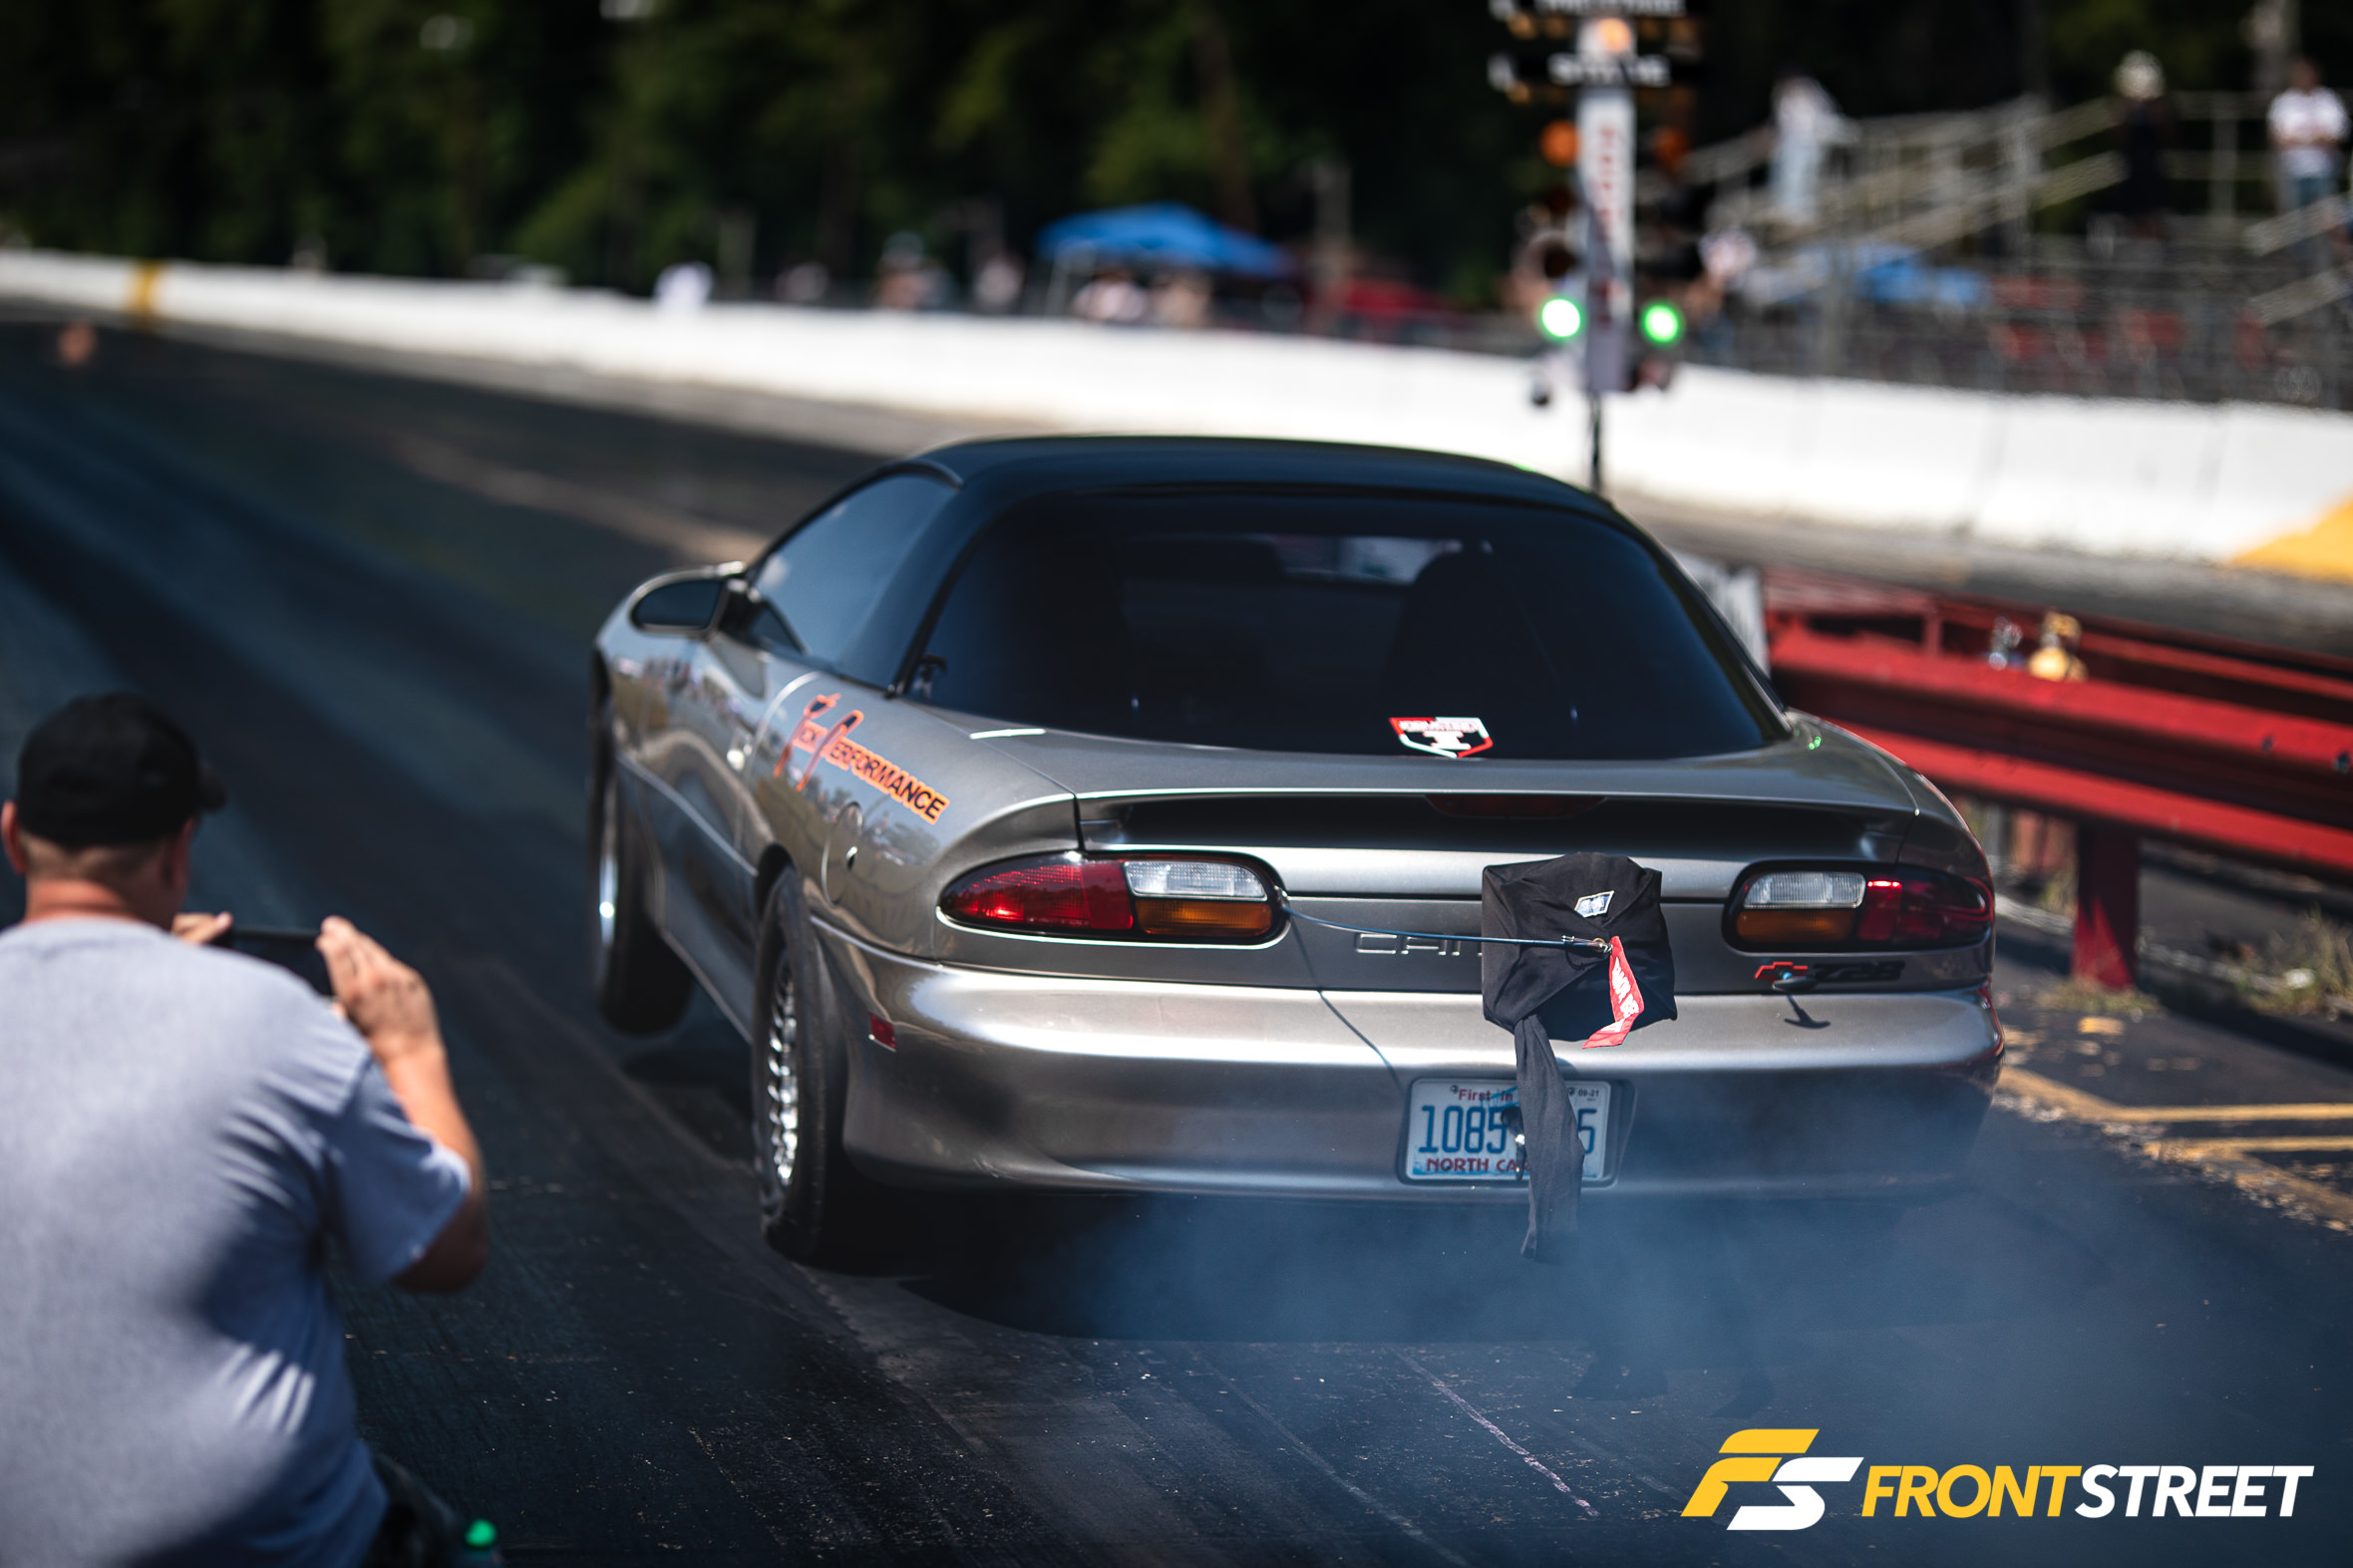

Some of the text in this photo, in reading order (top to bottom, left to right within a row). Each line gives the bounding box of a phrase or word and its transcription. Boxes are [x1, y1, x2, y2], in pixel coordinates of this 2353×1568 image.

[1811, 960, 1905, 982] Z28
[1459, 1089, 1492, 1101] First
[1426, 1157, 1490, 1173] NORTH
